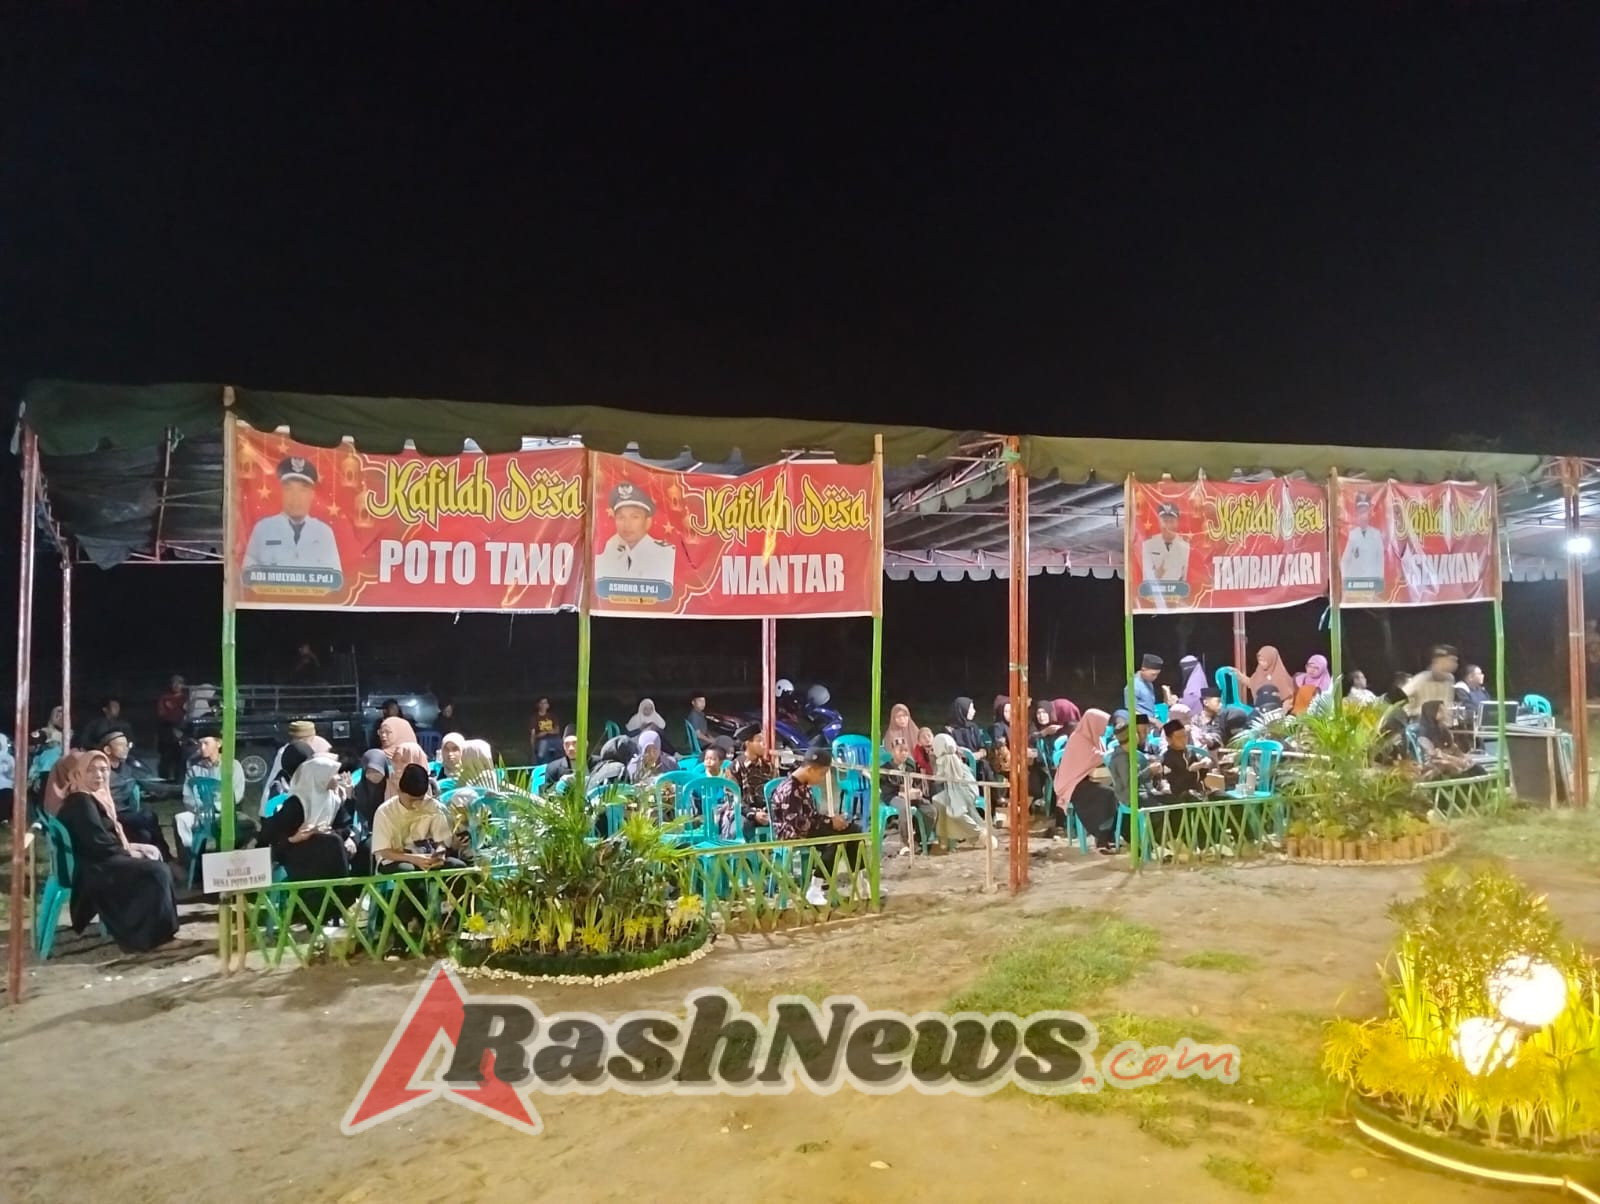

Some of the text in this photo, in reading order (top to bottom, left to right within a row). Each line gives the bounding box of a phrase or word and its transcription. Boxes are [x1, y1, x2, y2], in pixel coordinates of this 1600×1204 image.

[366, 457, 495, 530] Kafilah
[691, 474, 793, 546] Kafilah
[250, 571, 267, 582] ADI
[379, 539, 574, 586] POTO TANO
[721, 553, 845, 596] MANTAR
[1212, 551, 1322, 591] TAMBAK SARI
